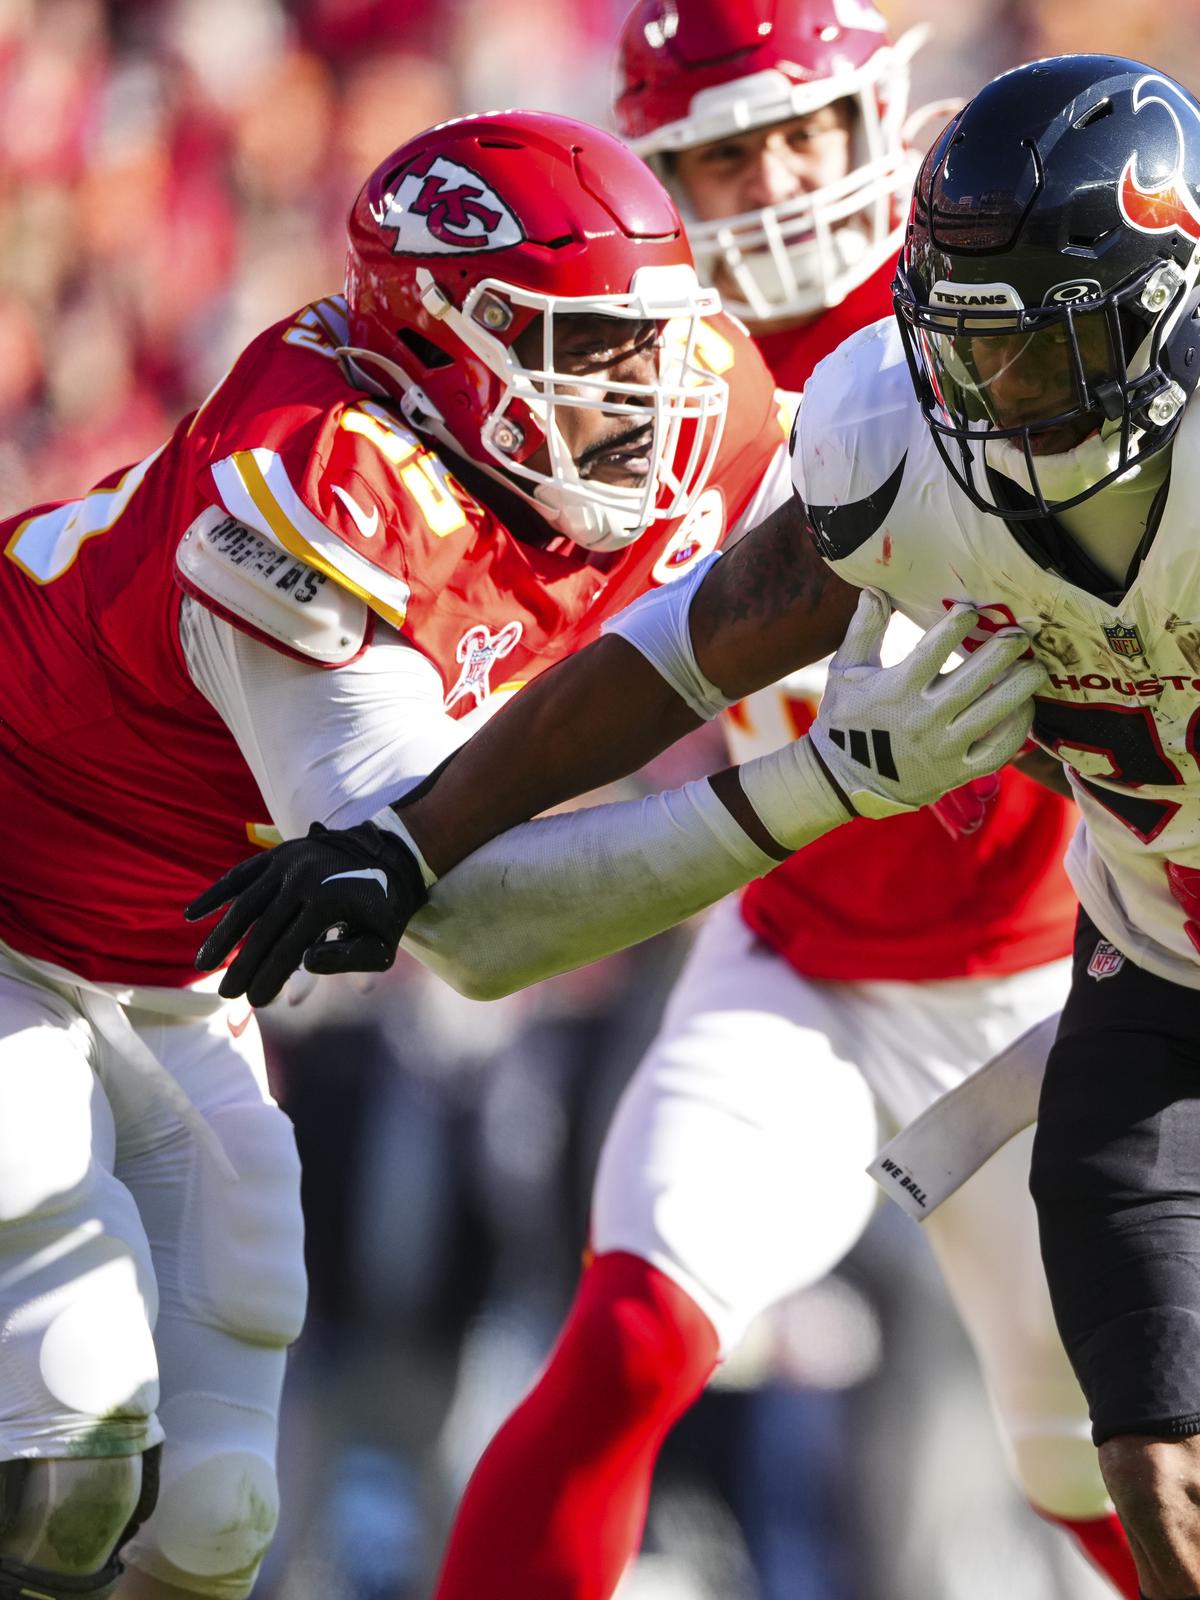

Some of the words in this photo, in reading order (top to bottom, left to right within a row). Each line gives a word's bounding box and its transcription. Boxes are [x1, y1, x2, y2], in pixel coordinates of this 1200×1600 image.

[408, 175, 503, 247] KC
[933, 291, 1008, 305] TEXANS
[1111, 638, 1140, 653] NFL
[880, 1158, 904, 1180] WE
